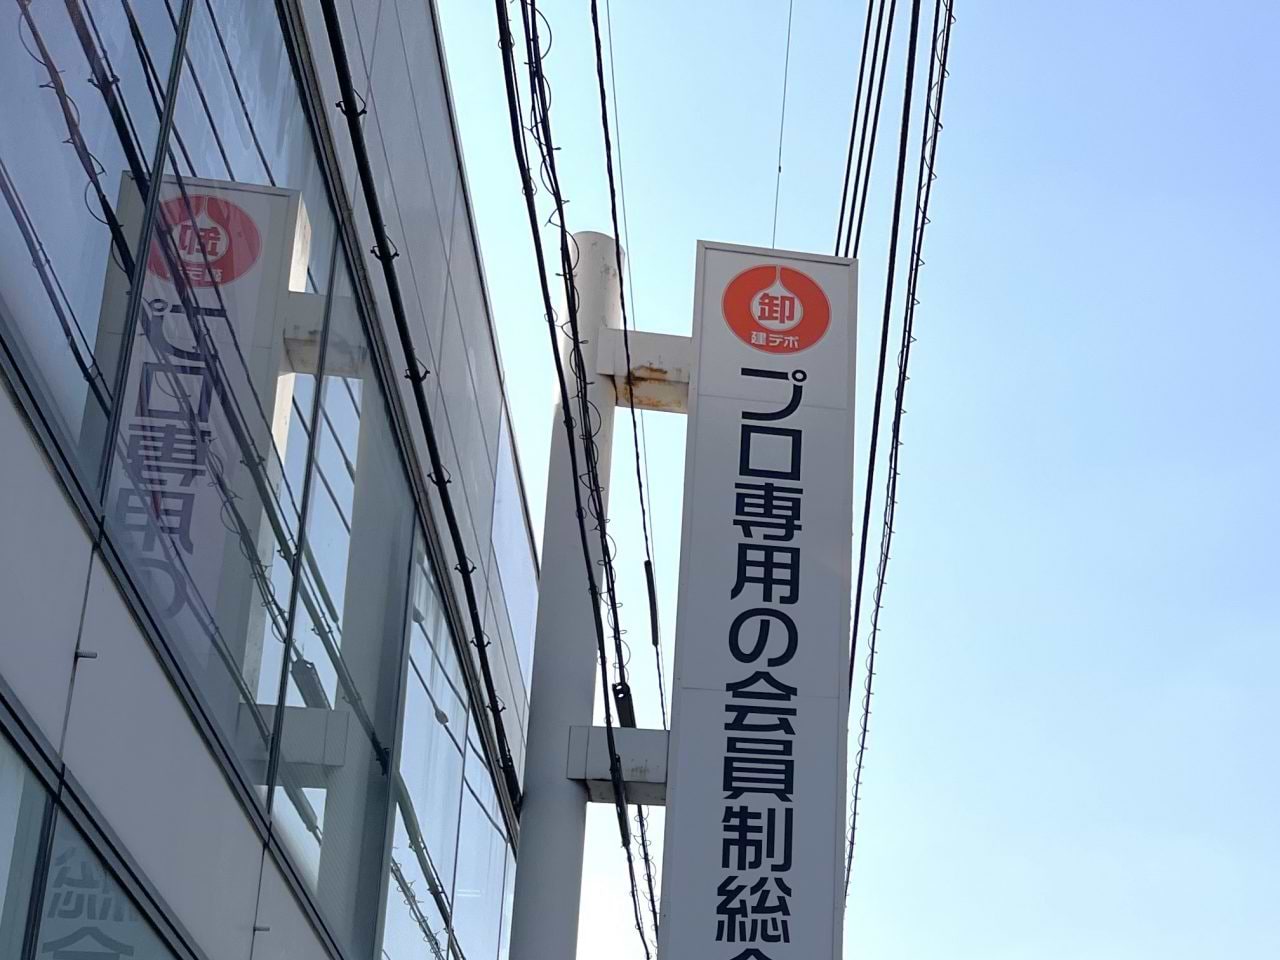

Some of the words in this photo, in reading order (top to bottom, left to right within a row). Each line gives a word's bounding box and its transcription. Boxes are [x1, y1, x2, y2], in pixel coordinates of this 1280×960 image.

[757, 291, 796, 325] 卸
[750, 330, 800, 349] 建デポ
